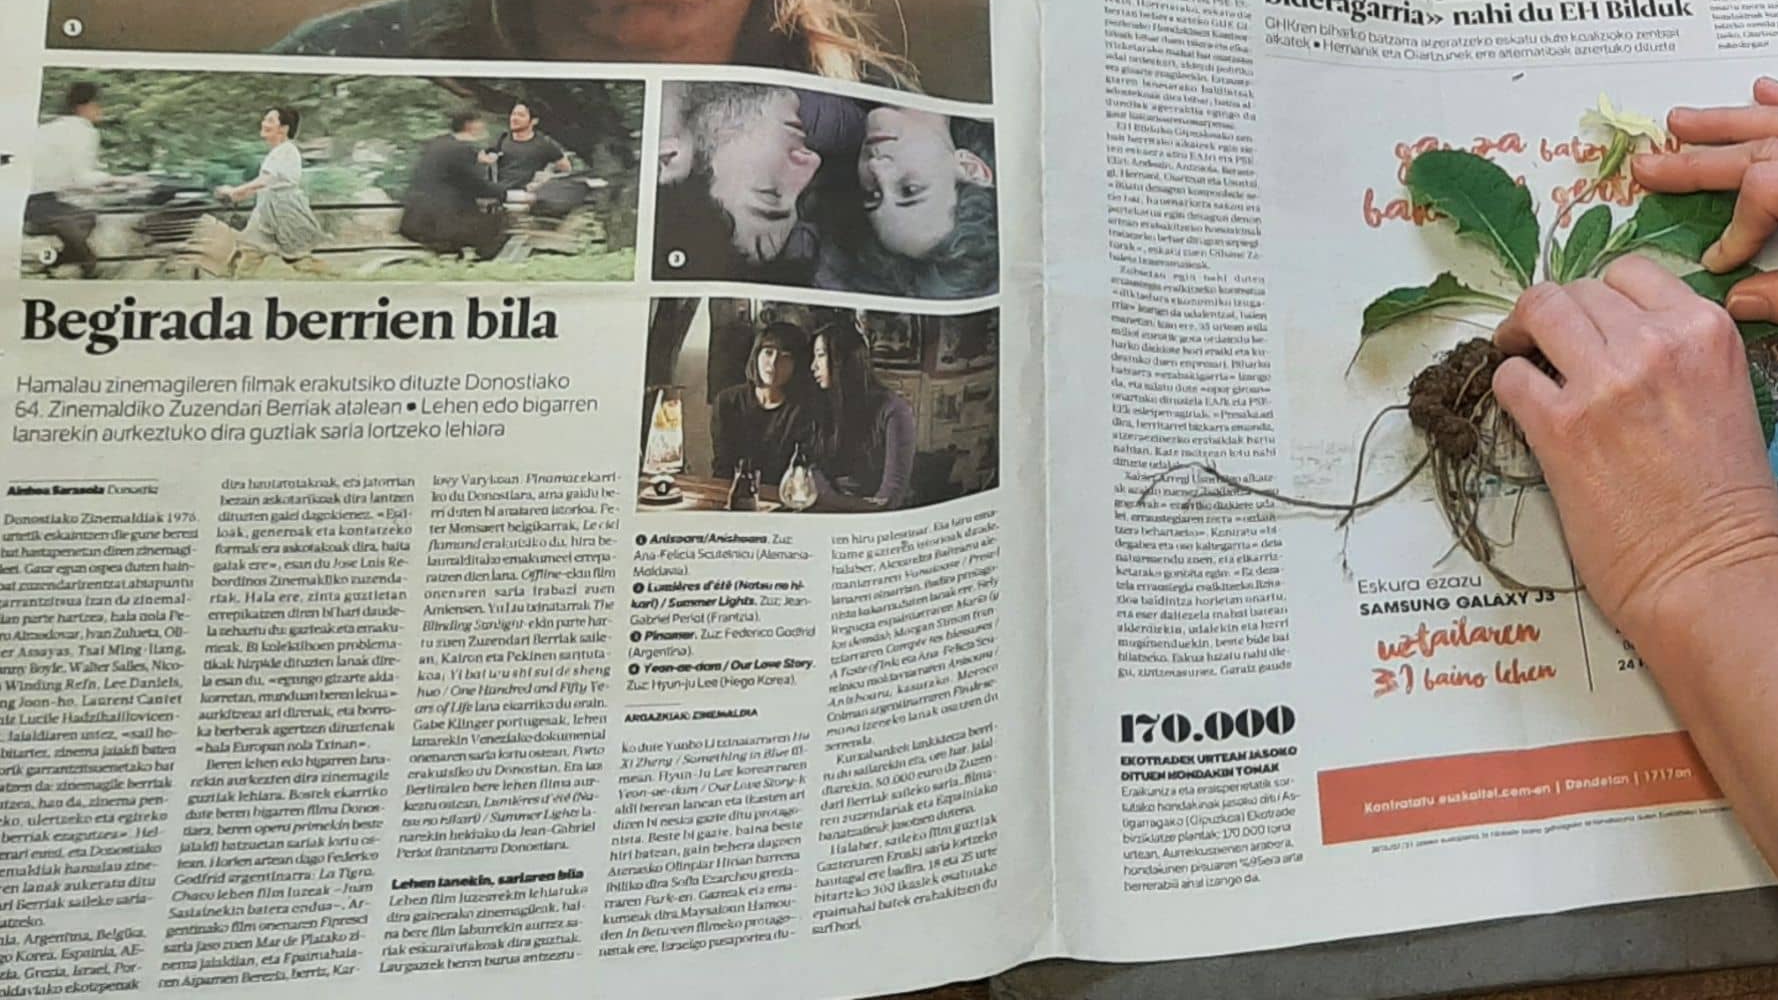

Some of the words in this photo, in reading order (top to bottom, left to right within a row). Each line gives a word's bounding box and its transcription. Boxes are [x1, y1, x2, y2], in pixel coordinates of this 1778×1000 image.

[1453, 2, 1513, 26] nahi
[1518, 1, 1553, 22] du
[1560, 1, 1600, 21] EH
[1264, 16, 1318, 35] GHKren
[21, 296, 252, 355] Begirada
[264, 296, 456, 341] berrien
[466, 295, 559, 340] bila
[16, 375, 102, 394] Hamalau
[104, 375, 238, 397] zinemagileren
[241, 374, 296, 394] filmak
[299, 374, 396, 393] erakutsiko
[400, 373, 462, 392] dituzte
[464, 372, 571, 392] Donostiako
[14, 400, 43, 418] 64.
[47, 399, 165, 418] Zinemaldiko
[168, 398, 262, 418] Zuzendari
[265, 398, 331, 418] Berriak
[334, 397, 402, 416] atalean
[420, 397, 479, 416] Lehen
[482, 396, 519, 415] edo
[522, 396, 598, 418] bigarren
[12, 425, 99, 444] lanarekin
[101, 424, 208, 443] aurkeztuko
[210, 424, 246, 442] dira
[249, 423, 317, 447] guztiak
[320, 421, 364, 441] saria
[367, 421, 441, 440] lortzeko
[445, 420, 506, 440] lehiara
[3, 512, 80, 527] Donostiako
[80, 511, 164, 526] Zinemaldiak
[1357, 577, 1421, 594] Eskura
[1425, 575, 1482, 591] ezazu
[1359, 597, 1451, 617] SAMSUNG
[1456, 591, 1529, 610] GALAXY
[1534, 590, 1556, 604] J3
[630, 613, 670, 626] Gabriel
[724, 626, 774, 639] Federico
[1376, 615, 1541, 662] uztailaren
[730, 659, 753, 671] Our
[753, 658, 782, 670] Love
[1423, 668, 1487, 692] baino
[1494, 657, 1557, 686] lehen
[1617, 658, 1635, 672] 24
[696, 676, 719, 688] Lee
[1120, 704, 1296, 744] 170.000
[1120, 755, 1195, 767] EKOTRADEK
[1196, 751, 1247, 764] URTEAN
[1248, 746, 1298, 759] JASOKO
[1120, 771, 1166, 782] DITUEN
[1167, 768, 1234, 781] HONDAKIN
[1235, 763, 1280, 775] TONAK
[1363, 793, 1436, 816] Kontratatu
[391, 878, 436, 891] Lehen
